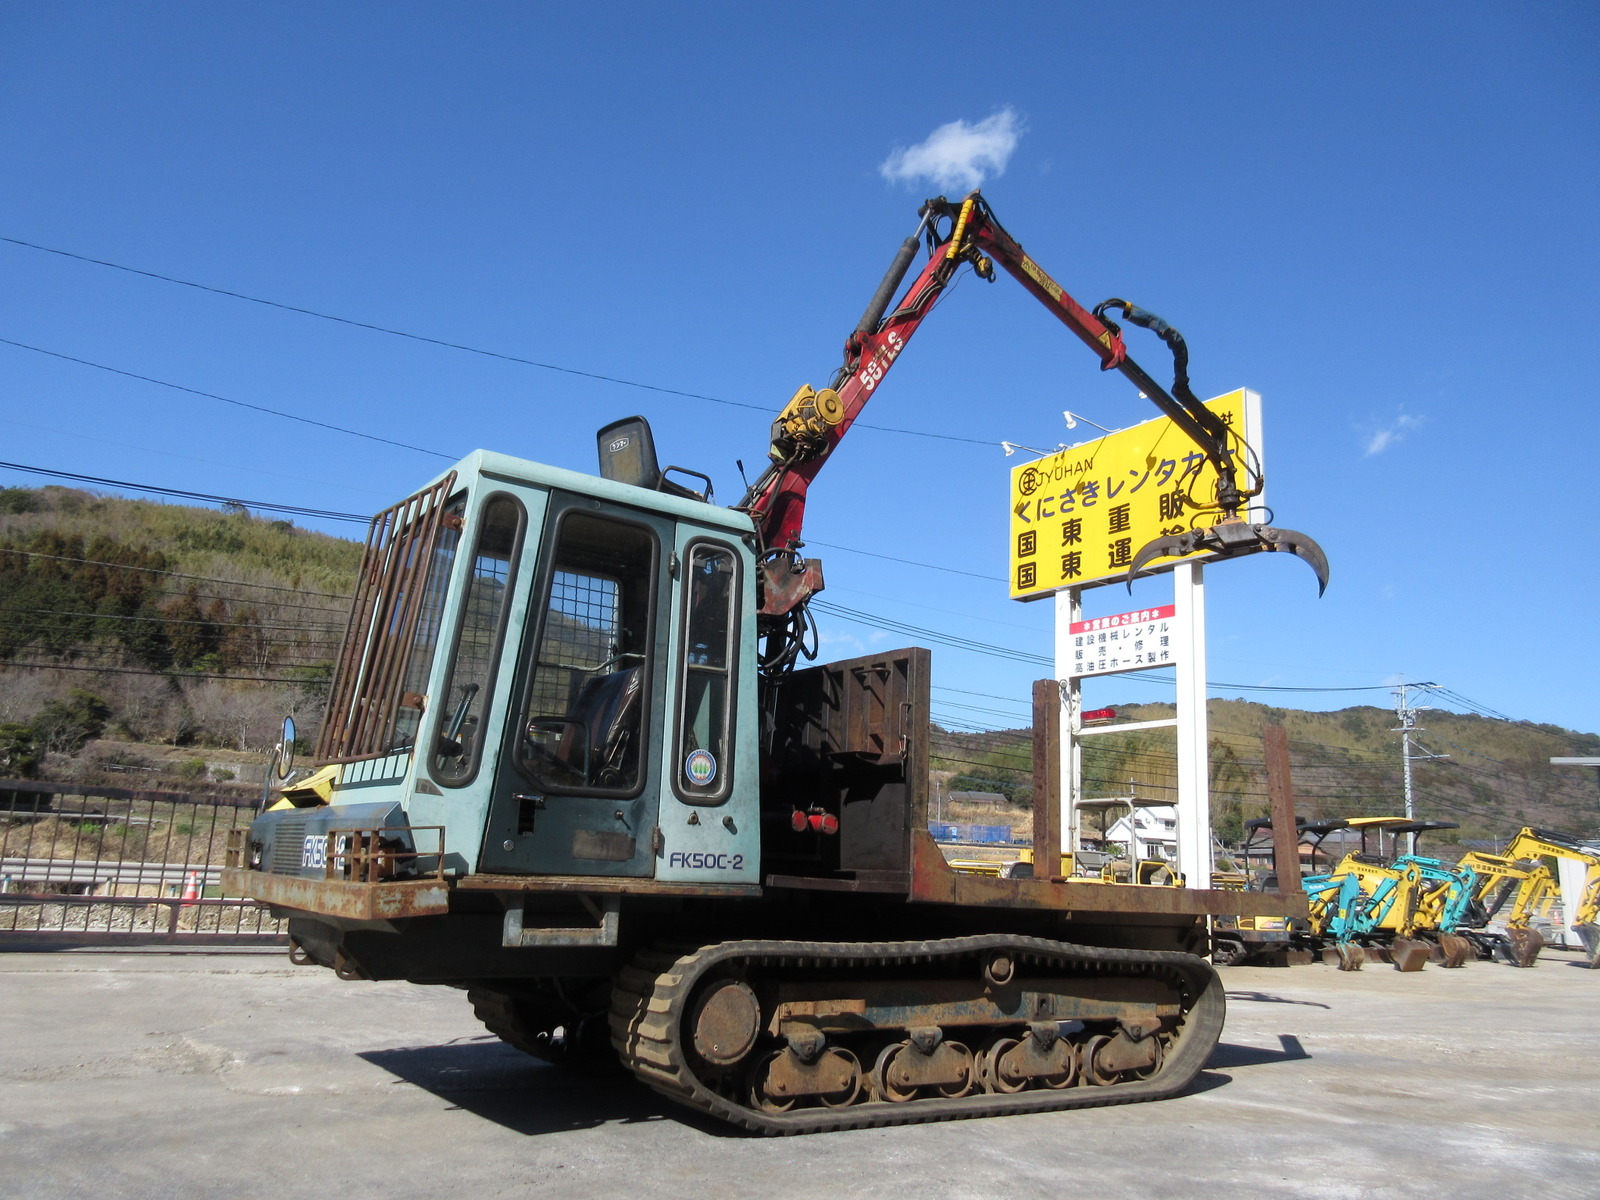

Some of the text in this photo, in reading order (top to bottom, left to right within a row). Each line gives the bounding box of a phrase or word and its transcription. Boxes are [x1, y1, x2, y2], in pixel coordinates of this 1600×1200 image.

[1075, 622, 1169, 647] 建設機械レンタル
[669, 852, 744, 870] FK50C-2
